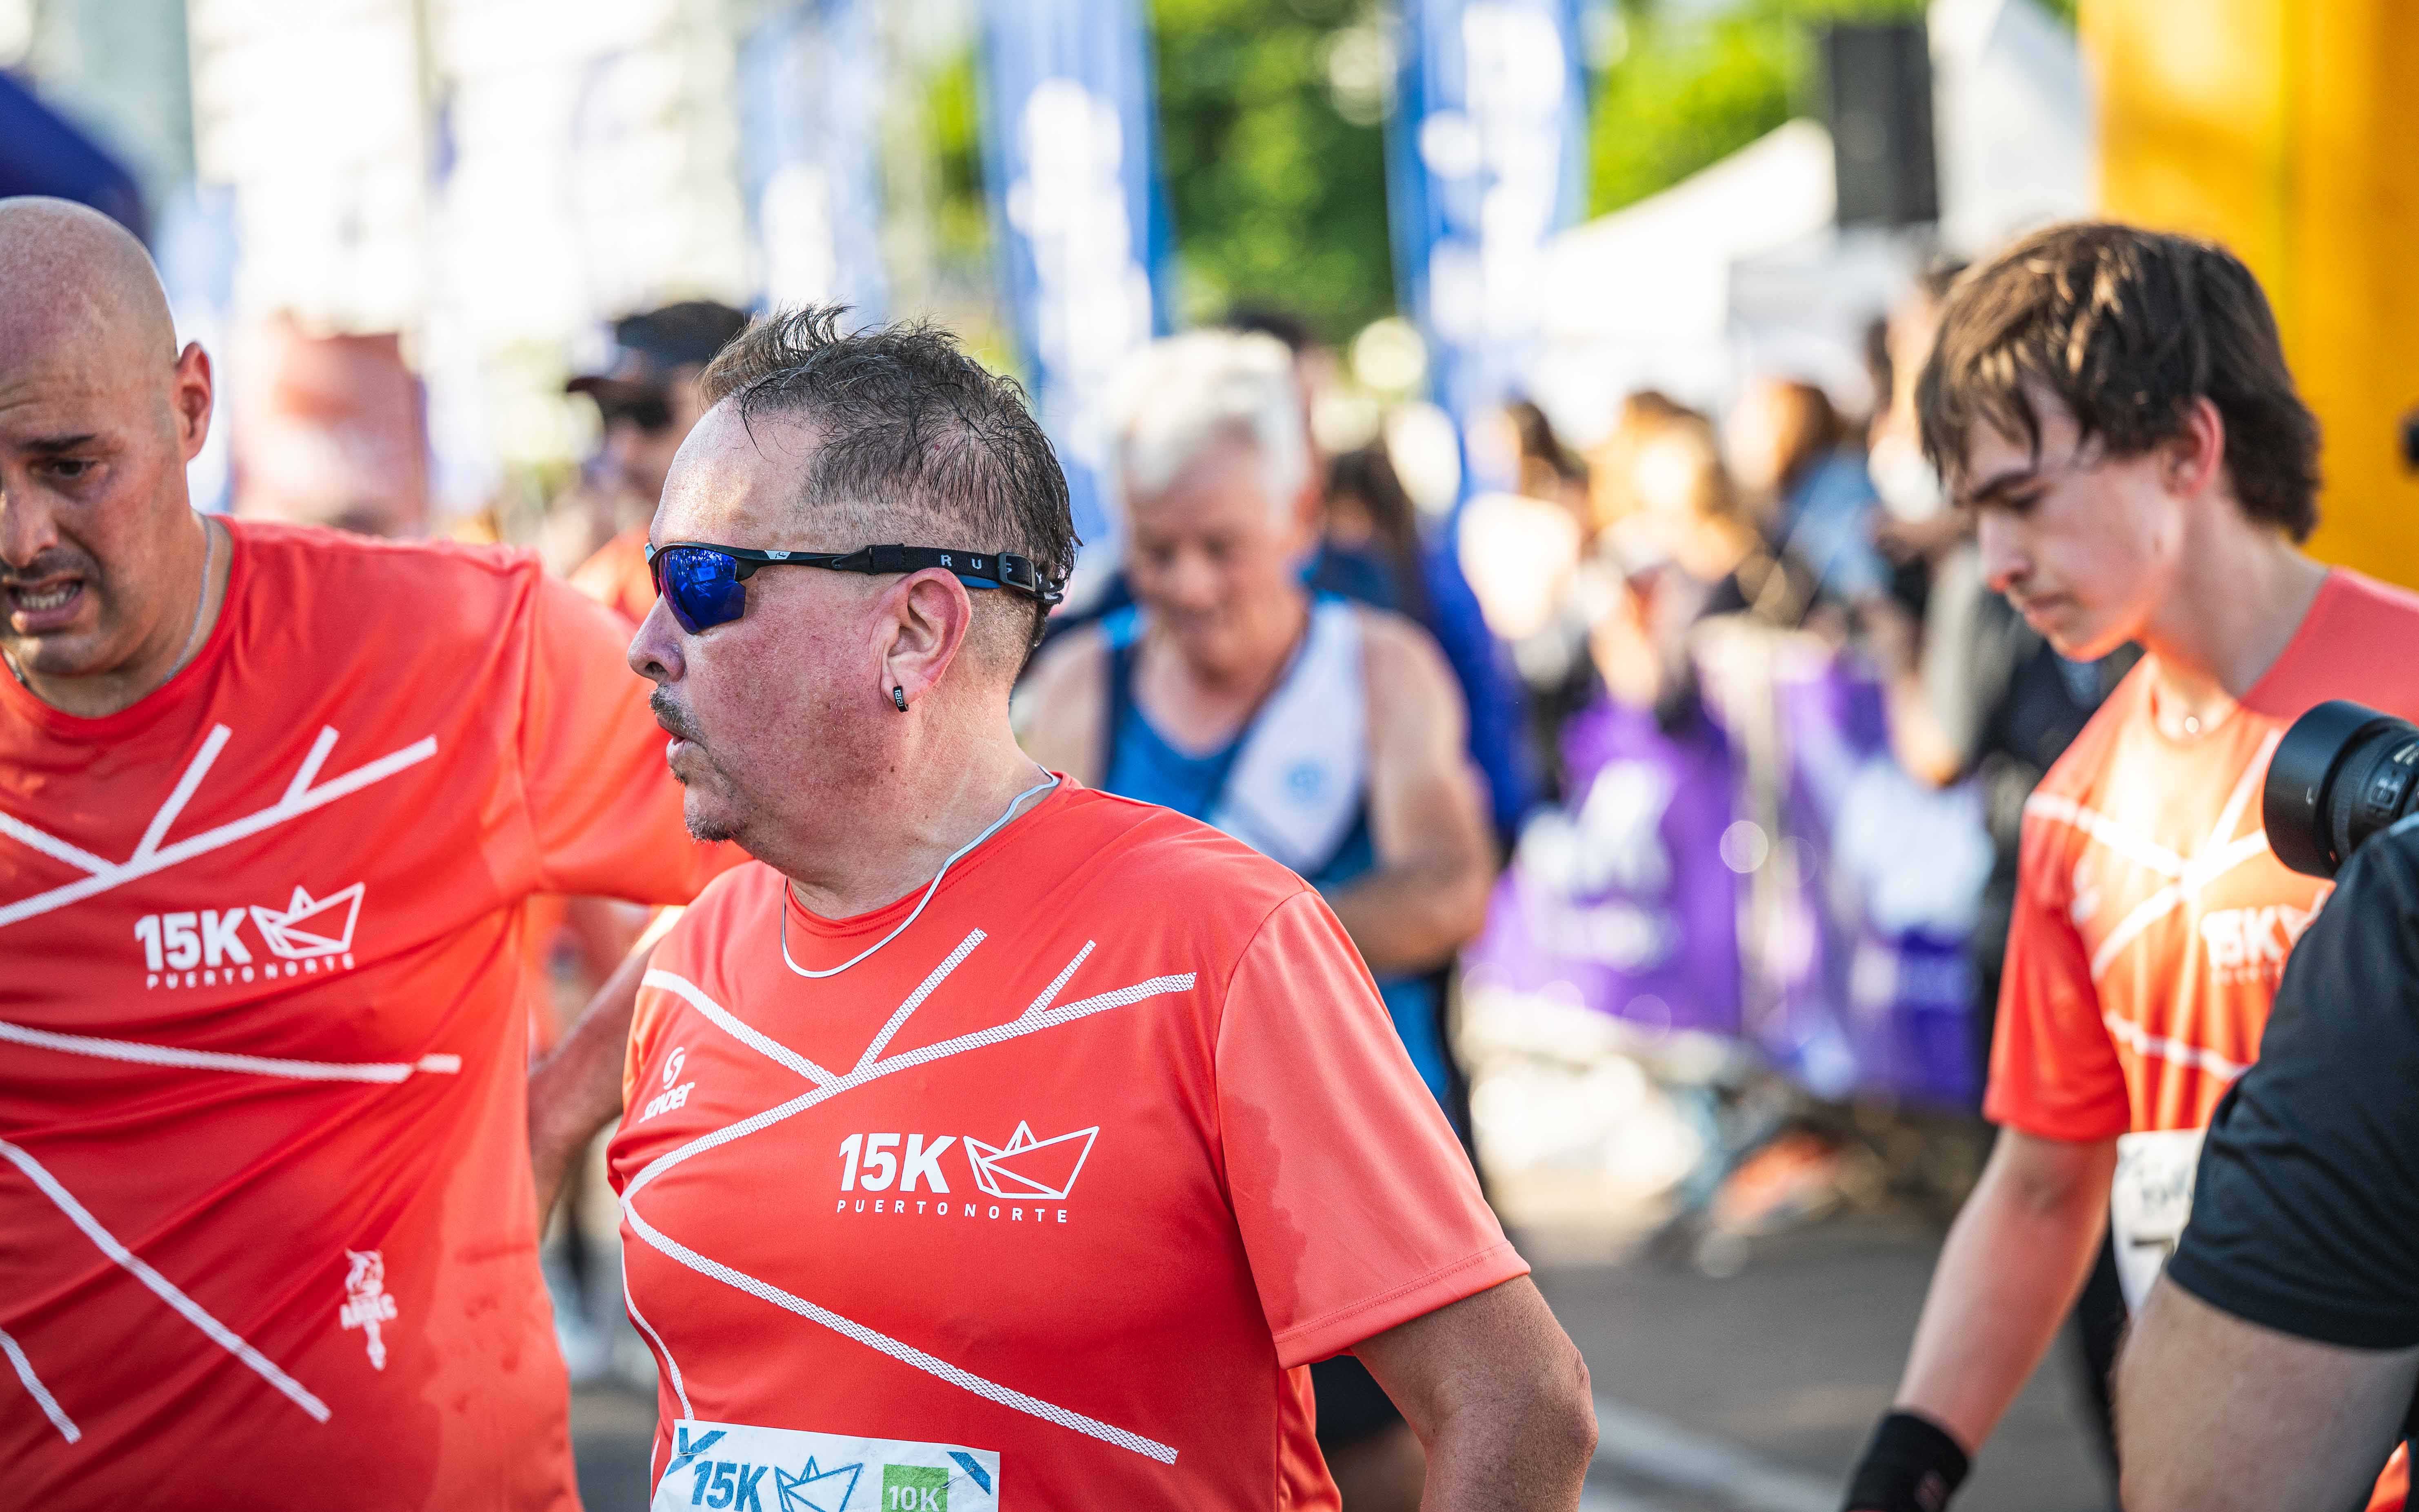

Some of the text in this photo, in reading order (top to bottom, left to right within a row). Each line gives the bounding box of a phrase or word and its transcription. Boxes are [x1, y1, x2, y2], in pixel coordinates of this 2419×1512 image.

[134, 907, 253, 972] 15K
[146, 965, 255, 990] PUERTO
[839, 1133, 957, 1193] 15K
[837, 1200, 1067, 1223] PUERTO NORTE
[692, 1460, 769, 1512] 15K
[889, 1485, 941, 1512] 10K
